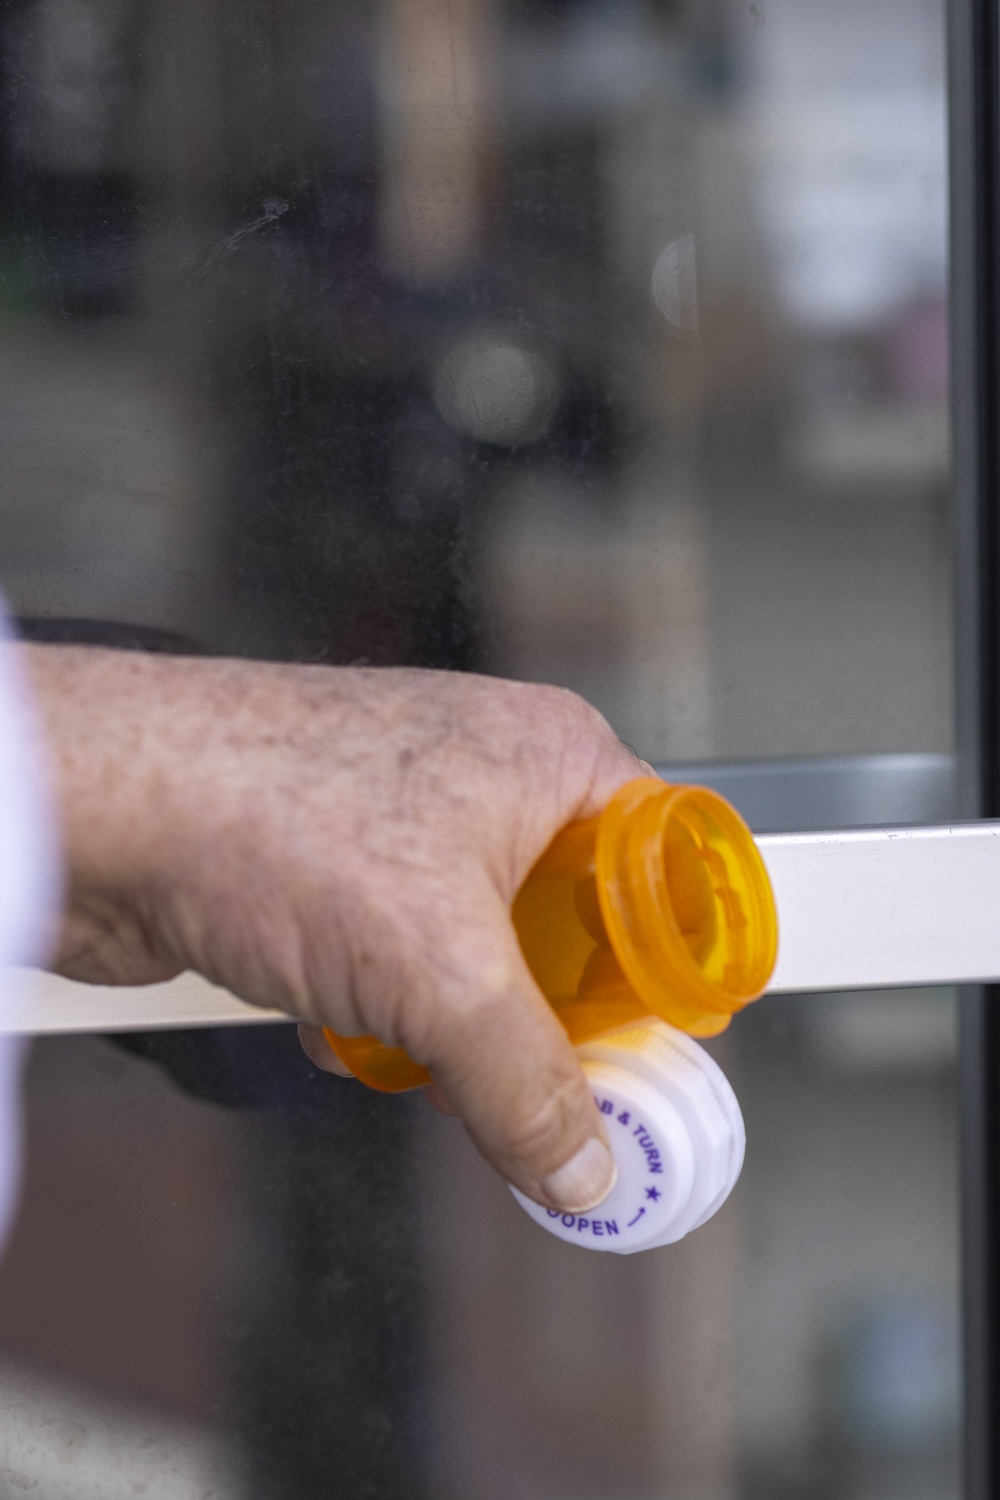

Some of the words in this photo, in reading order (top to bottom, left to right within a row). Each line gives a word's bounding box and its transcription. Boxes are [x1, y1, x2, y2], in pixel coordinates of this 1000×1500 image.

[617, 1111, 631, 1126] &
[633, 1124, 663, 1174] TURN
[561, 1214, 620, 1236] OPEN
